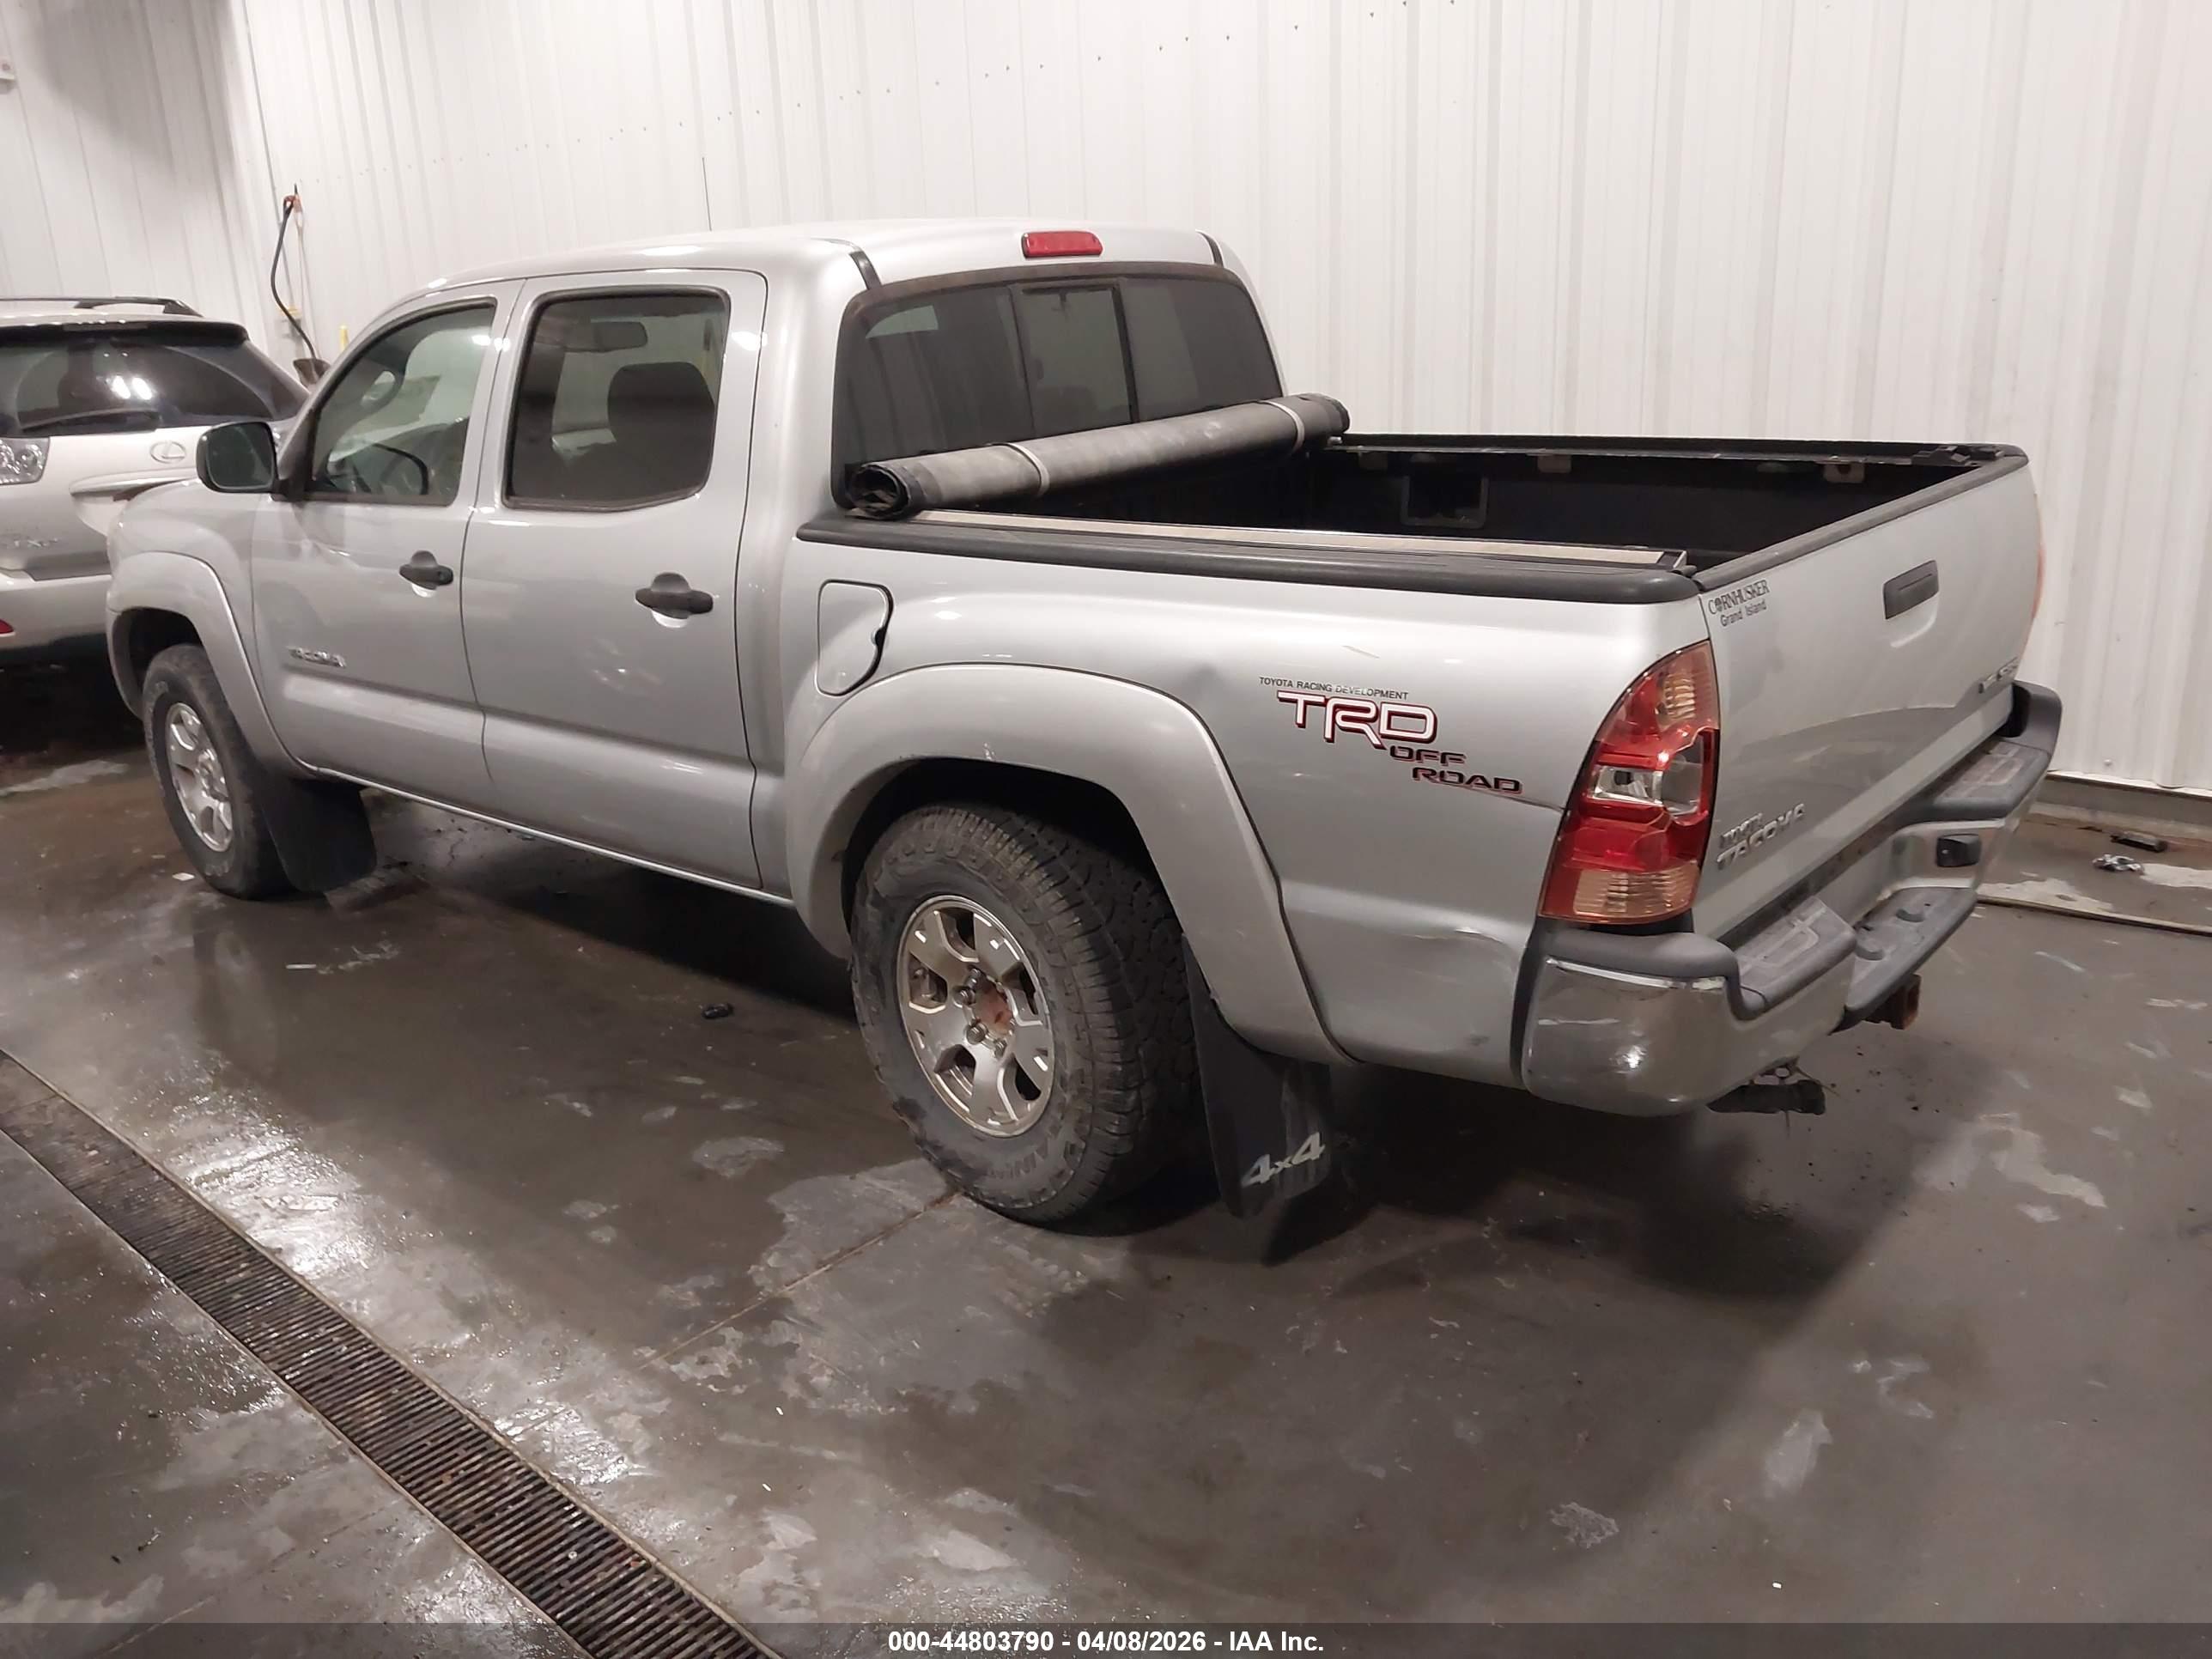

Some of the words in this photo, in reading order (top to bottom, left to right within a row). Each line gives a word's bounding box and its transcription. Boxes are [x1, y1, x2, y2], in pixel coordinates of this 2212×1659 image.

[1720, 609, 1743, 627] Grand
[1745, 598, 1767, 617] Island
[1259, 677, 1294, 689] TOYOTA
[1297, 680, 1333, 692] RACING
[1334, 684, 1409, 701] DEVELOPMENT
[1277, 690, 1438, 750] TRD
[1389, 745, 1467, 766] OFF
[1412, 767, 1523, 794] ROAD
